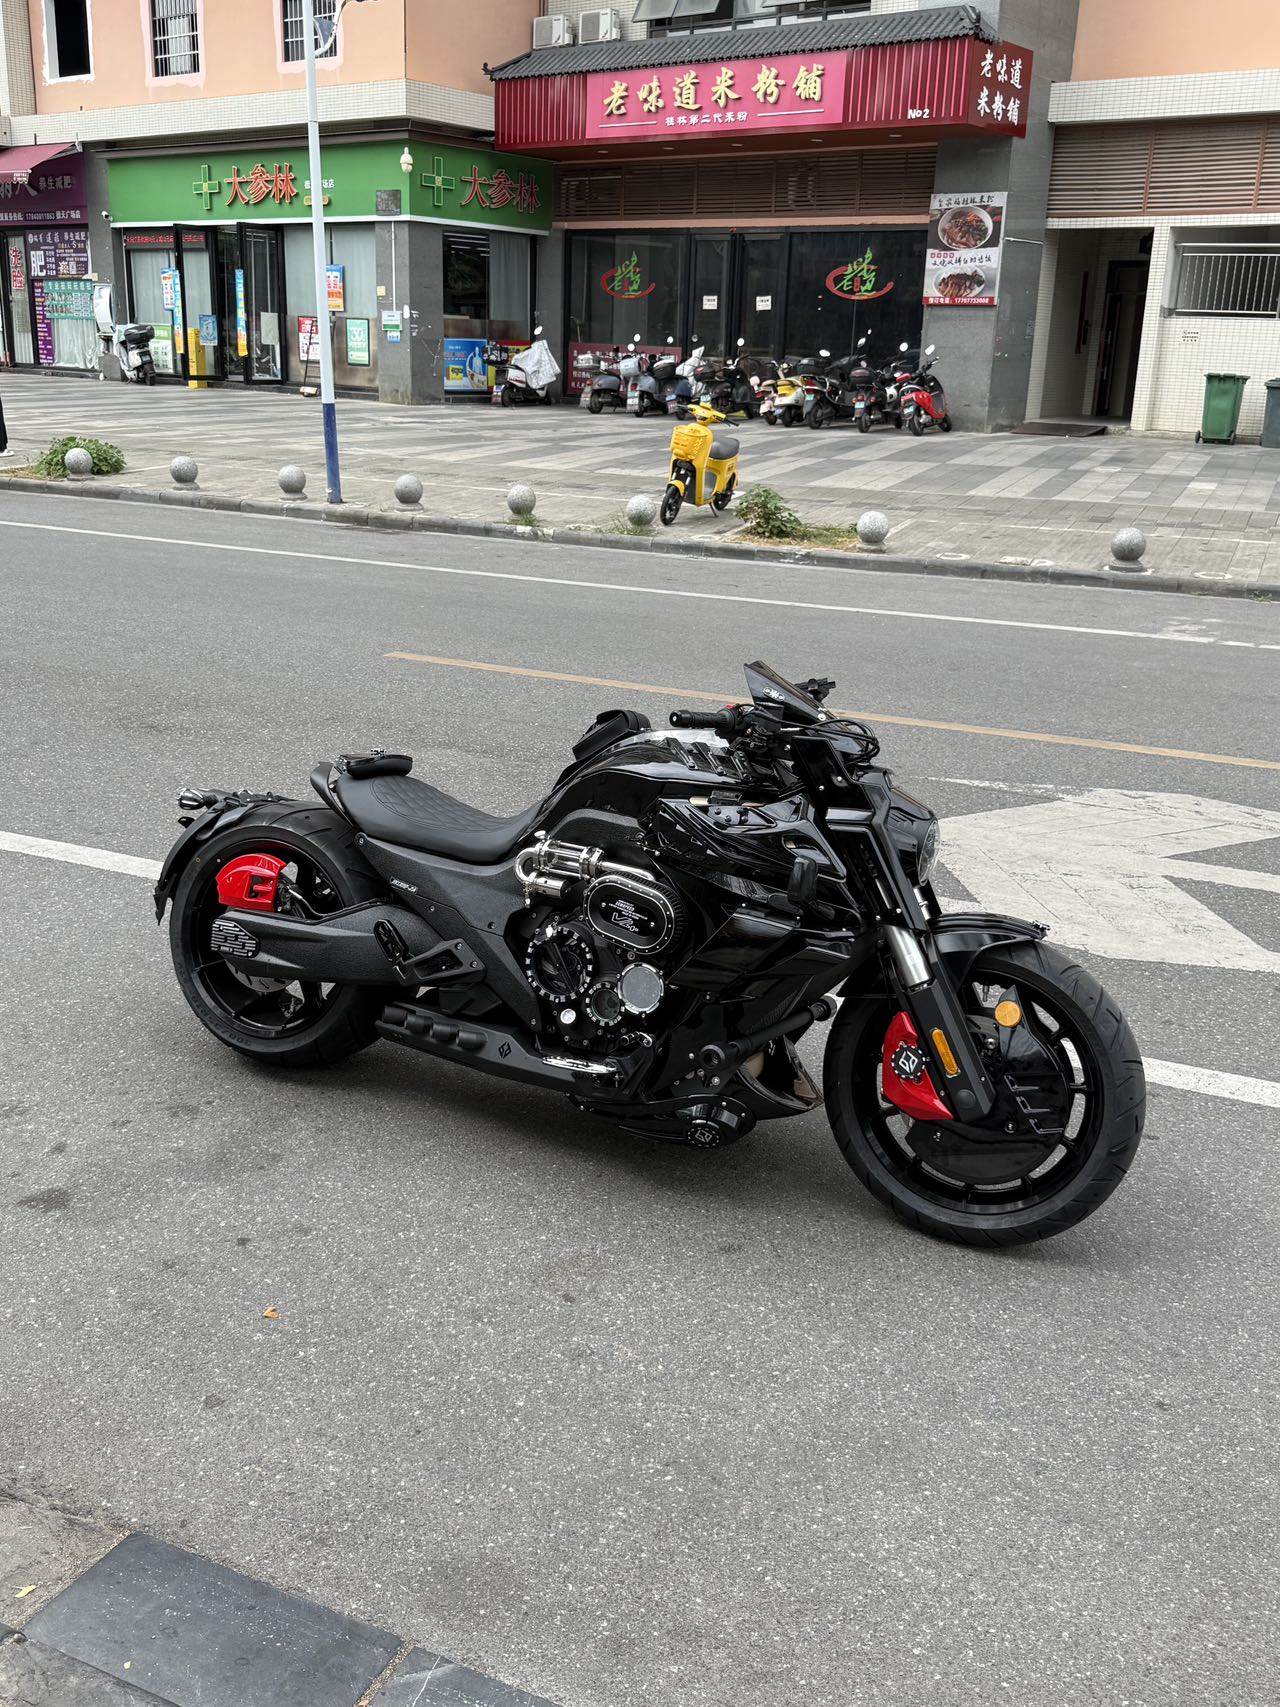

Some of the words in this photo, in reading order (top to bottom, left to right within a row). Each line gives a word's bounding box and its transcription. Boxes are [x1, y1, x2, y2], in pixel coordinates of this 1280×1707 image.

[980, 48, 1023, 89] 老味道
[602, 63, 825, 117] 老味道米粉铺
[977, 86, 1021, 126] 米粉铺
[664, 111, 748, 126] 桂林第二代米粉
[224, 162, 298, 206] 大参林
[460, 164, 541, 213] 大参林
[9, 246, 24, 290] 洗脸
[30, 251, 46, 277] 肥
